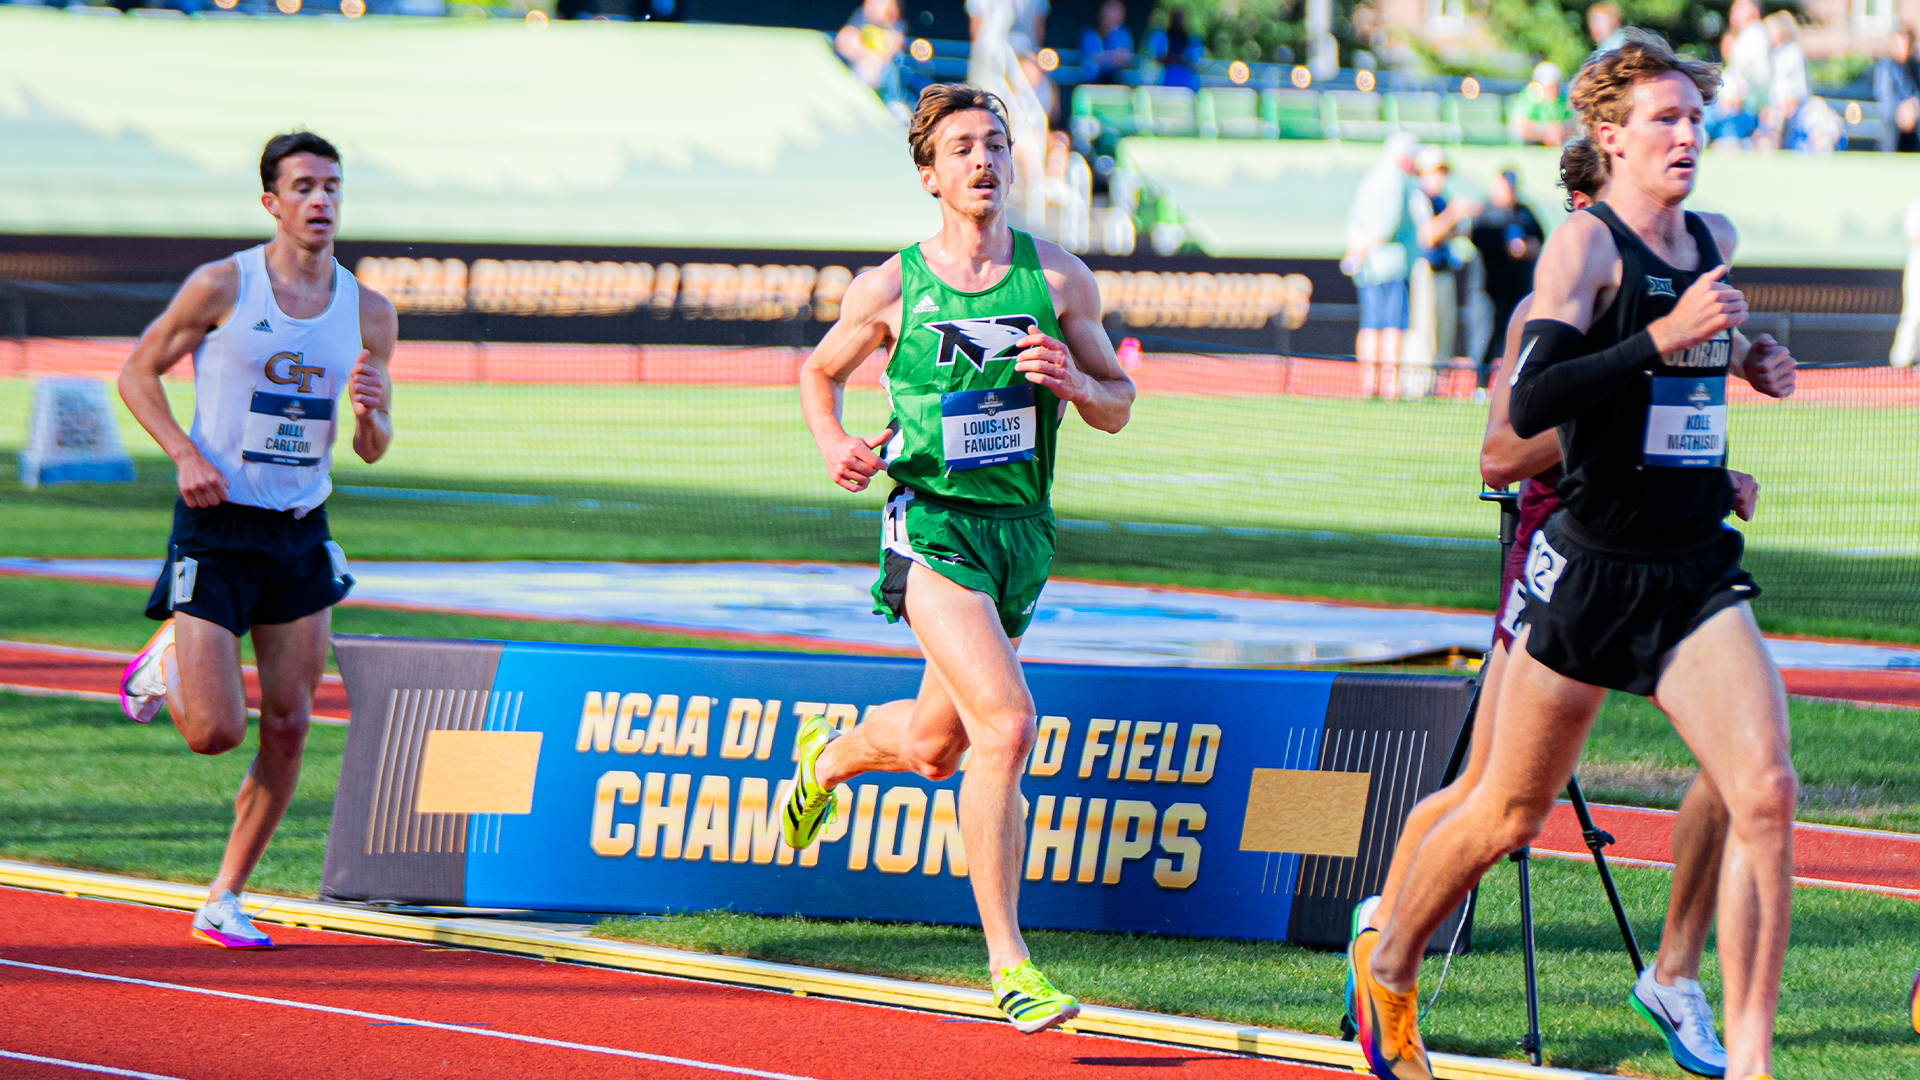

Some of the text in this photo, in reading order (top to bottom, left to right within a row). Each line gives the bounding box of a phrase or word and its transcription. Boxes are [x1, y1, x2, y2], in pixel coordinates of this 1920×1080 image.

[912, 304, 940, 314] adidas
[264, 351, 326, 393] GT
[277, 423, 306, 438] BILLY
[963, 416, 1021, 436] LOUIS-LYS
[1686, 414, 1711, 430] KOLE
[264, 437, 312, 454] CARLTON
[964, 433, 1021, 453] FANUCCHI
[576, 691, 711, 757] NCAA
[720, 697, 781, 761] DI
[1078, 718, 1223, 783] FIELD
[590, 770, 1208, 889] CHAMPIONHIPS
